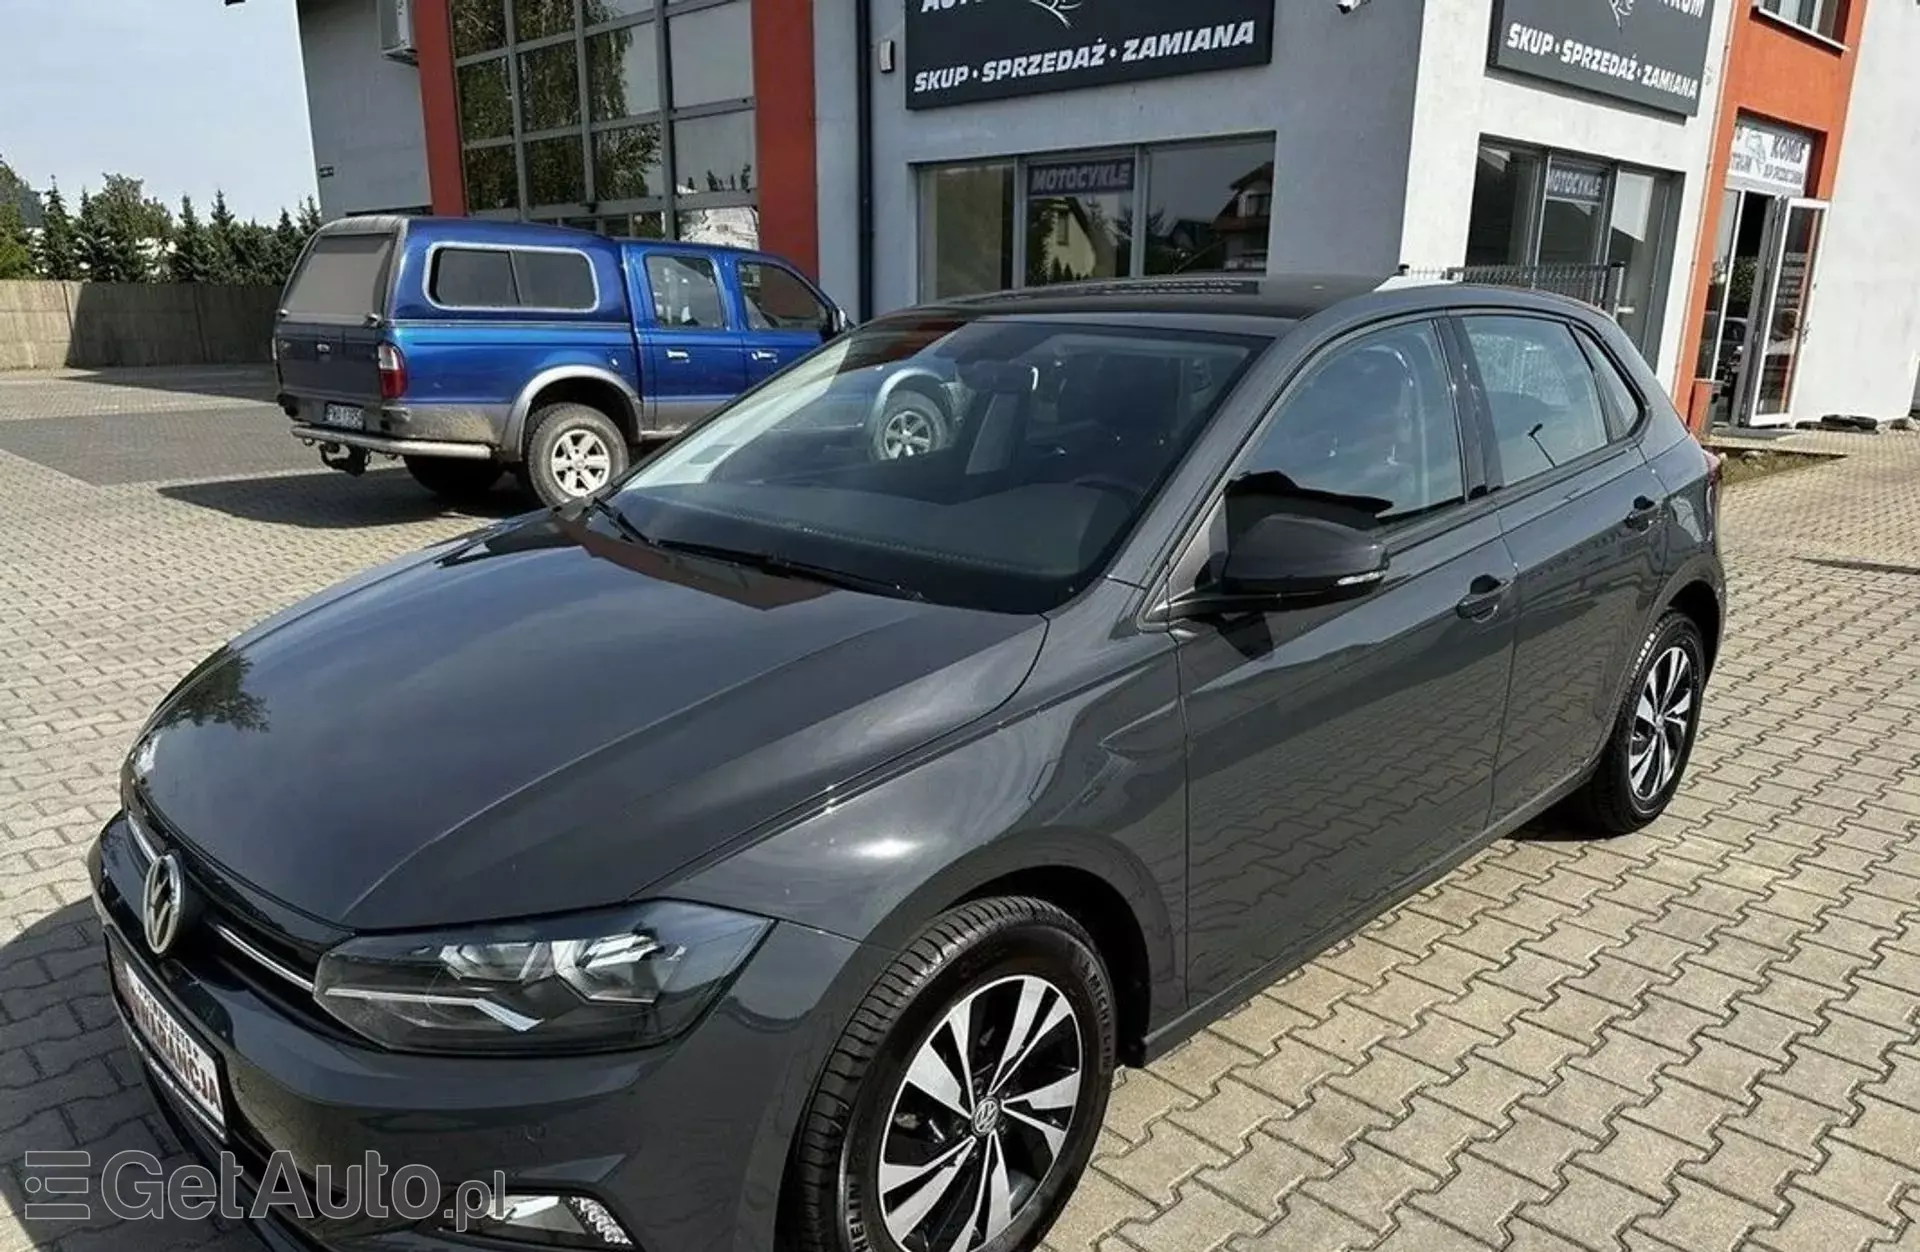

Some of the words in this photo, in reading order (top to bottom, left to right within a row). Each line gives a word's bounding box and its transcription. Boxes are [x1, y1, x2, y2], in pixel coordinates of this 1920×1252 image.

[913, 65, 969, 93] SKUP
[981, 37, 1108, 82] SPRZEDAŻ
[1121, 20, 1256, 62] ZAMIANA
[1506, 22, 1554, 56] SKUP
[1558, 39, 1638, 82] SPRZEDAŻ
[1641, 63, 1699, 100] ZAMIANA
[1031, 163, 1131, 192] MOTOCYKLE
